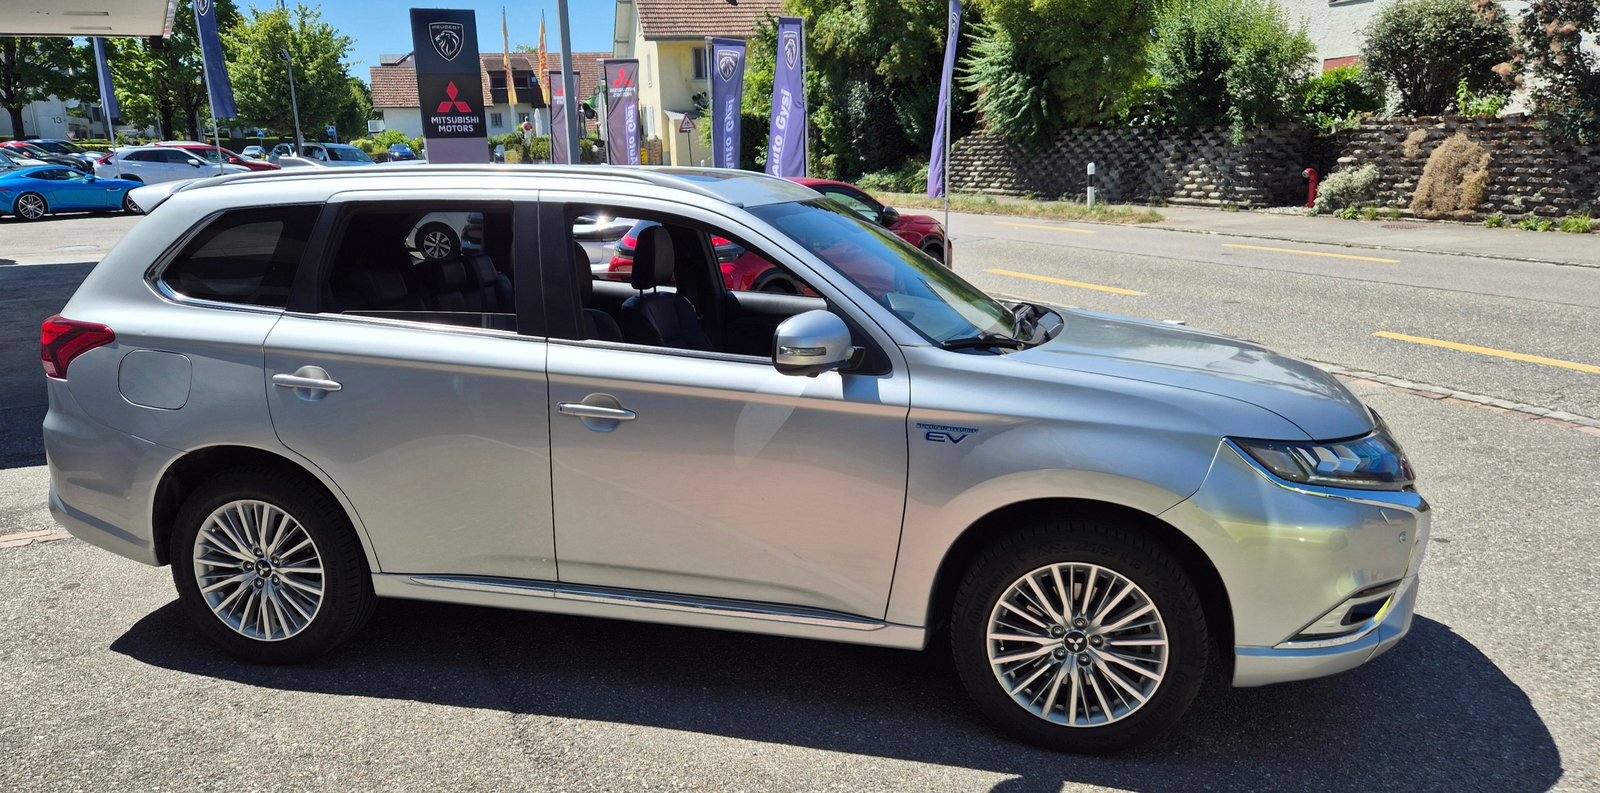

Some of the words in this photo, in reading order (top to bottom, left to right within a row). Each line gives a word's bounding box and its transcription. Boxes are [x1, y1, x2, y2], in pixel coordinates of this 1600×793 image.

[776, 88, 791, 130] Gysi
[52, 116, 63, 124] 13
[431, 116, 479, 124] MITSUBISHI
[438, 124, 474, 133] MOTORS
[772, 135, 783, 177] Auto
[926, 431, 967, 444] EV
